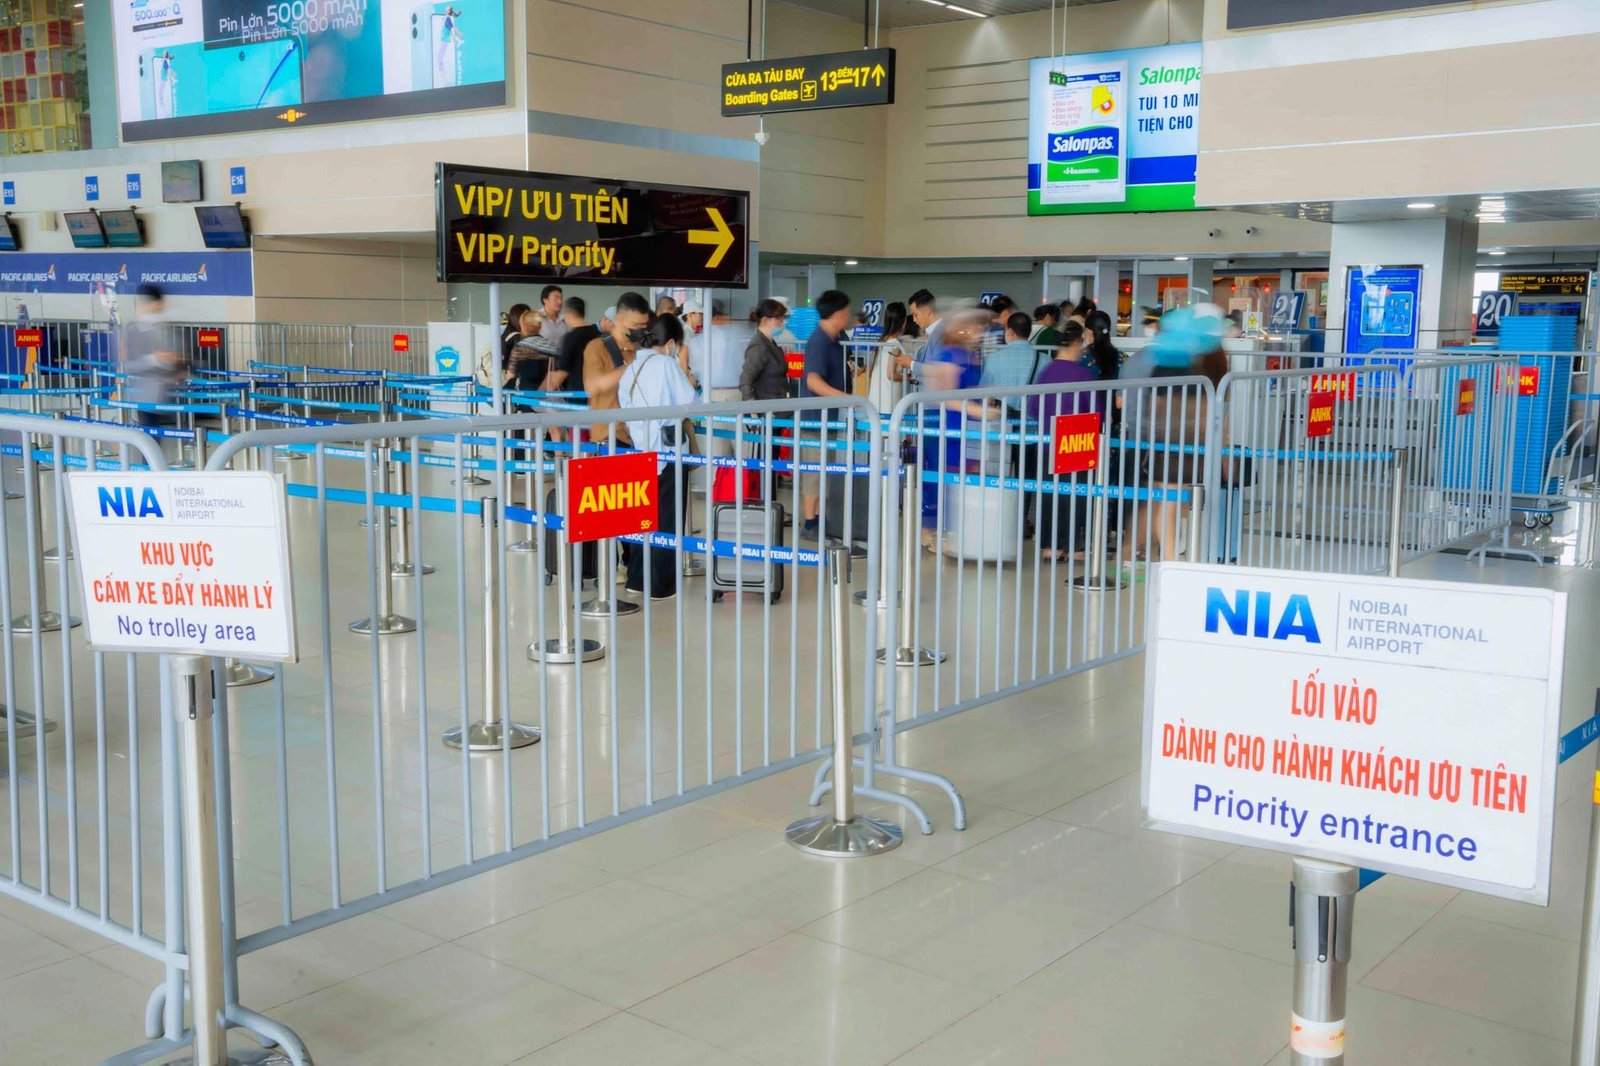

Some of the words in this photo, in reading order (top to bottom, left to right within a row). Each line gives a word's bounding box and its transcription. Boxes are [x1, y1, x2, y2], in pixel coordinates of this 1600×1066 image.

[219, 17, 238, 33] Pin
[241, 13, 264, 30] Lớn
[266, 0, 319, 26] 5000
[291, 16, 329, 36] 5000
[332, 12, 363, 30] mAh
[725, 70, 747, 87] CỬA
[748, 72, 763, 84] RA
[763, 67, 783, 83] TÀU
[785, 67, 806, 81] BAY
[820, 71, 838, 92] 13
[852, 66, 870, 88] 17
[725, 92, 769, 106] Boarding
[770, 88, 798, 102] Gates
[1163, 94, 1178, 109] 10
[1169, 115, 1193, 130] CHO
[1052, 135, 1114, 155] Salonpas
[127, 181, 139, 191] E15
[231, 175, 244, 185] E16
[455, 183, 513, 218] VIP/
[521, 189, 562, 221] ƯU
[570, 188, 629, 225] TIÊN
[456, 232, 514, 264] VIP/
[522, 235, 615, 275] Priority
[1, 272, 21, 282] PACIFIC
[22, 272, 48, 282] AIRLINES
[68, 272, 90, 282] PACIFIC
[90, 272, 118, 282] AIRLINES
[141, 272, 166, 283] PACIFIC
[167, 272, 198, 283] AIRLINES
[1273, 293, 1297, 325] 21
[1479, 294, 1511, 327] 20
[1310, 407, 1331, 423] ANHK
[1058, 432, 1095, 454] ANHK
[97, 486, 164, 518] NIA
[174, 487, 204, 496] NOIBAI
[577, 480, 650, 514] ANHK
[175, 499, 245, 509] INTERNATIONAL
[177, 511, 215, 520] AIRPORT
[140, 542, 175, 566] KHU
[179, 540, 214, 572] VỰC
[93, 571, 131, 603] CẤM
[135, 581, 157, 605] XE
[162, 572, 194, 606] ĐẨY
[200, 578, 249, 608] HÀNH
[253, 580, 273, 609] LÝ
[1204, 586, 1321, 644] NIA
[1349, 599, 1408, 617] NOIBAI
[117, 615, 143, 635] No
[149, 617, 207, 644] trolley
[215, 624, 256, 641] area
[1347, 618, 1489, 643] INTERNATIONAL
[1347, 637, 1423, 656] AIRPORT
[1291, 669, 1325, 719] LỐI
[1333, 677, 1377, 725] VÀO
[1162, 718, 1216, 764] DÀNH
[1223, 732, 1265, 772] CHO
[1272, 734, 1333, 783] HÀNH
[1341, 746, 1420, 796] KHÁCH
[1428, 759, 1461, 803] ƯU
[1471, 763, 1528, 814] TIÊN
[1193, 784, 1308, 838] Priority
[1319, 808, 1478, 862] entrance
